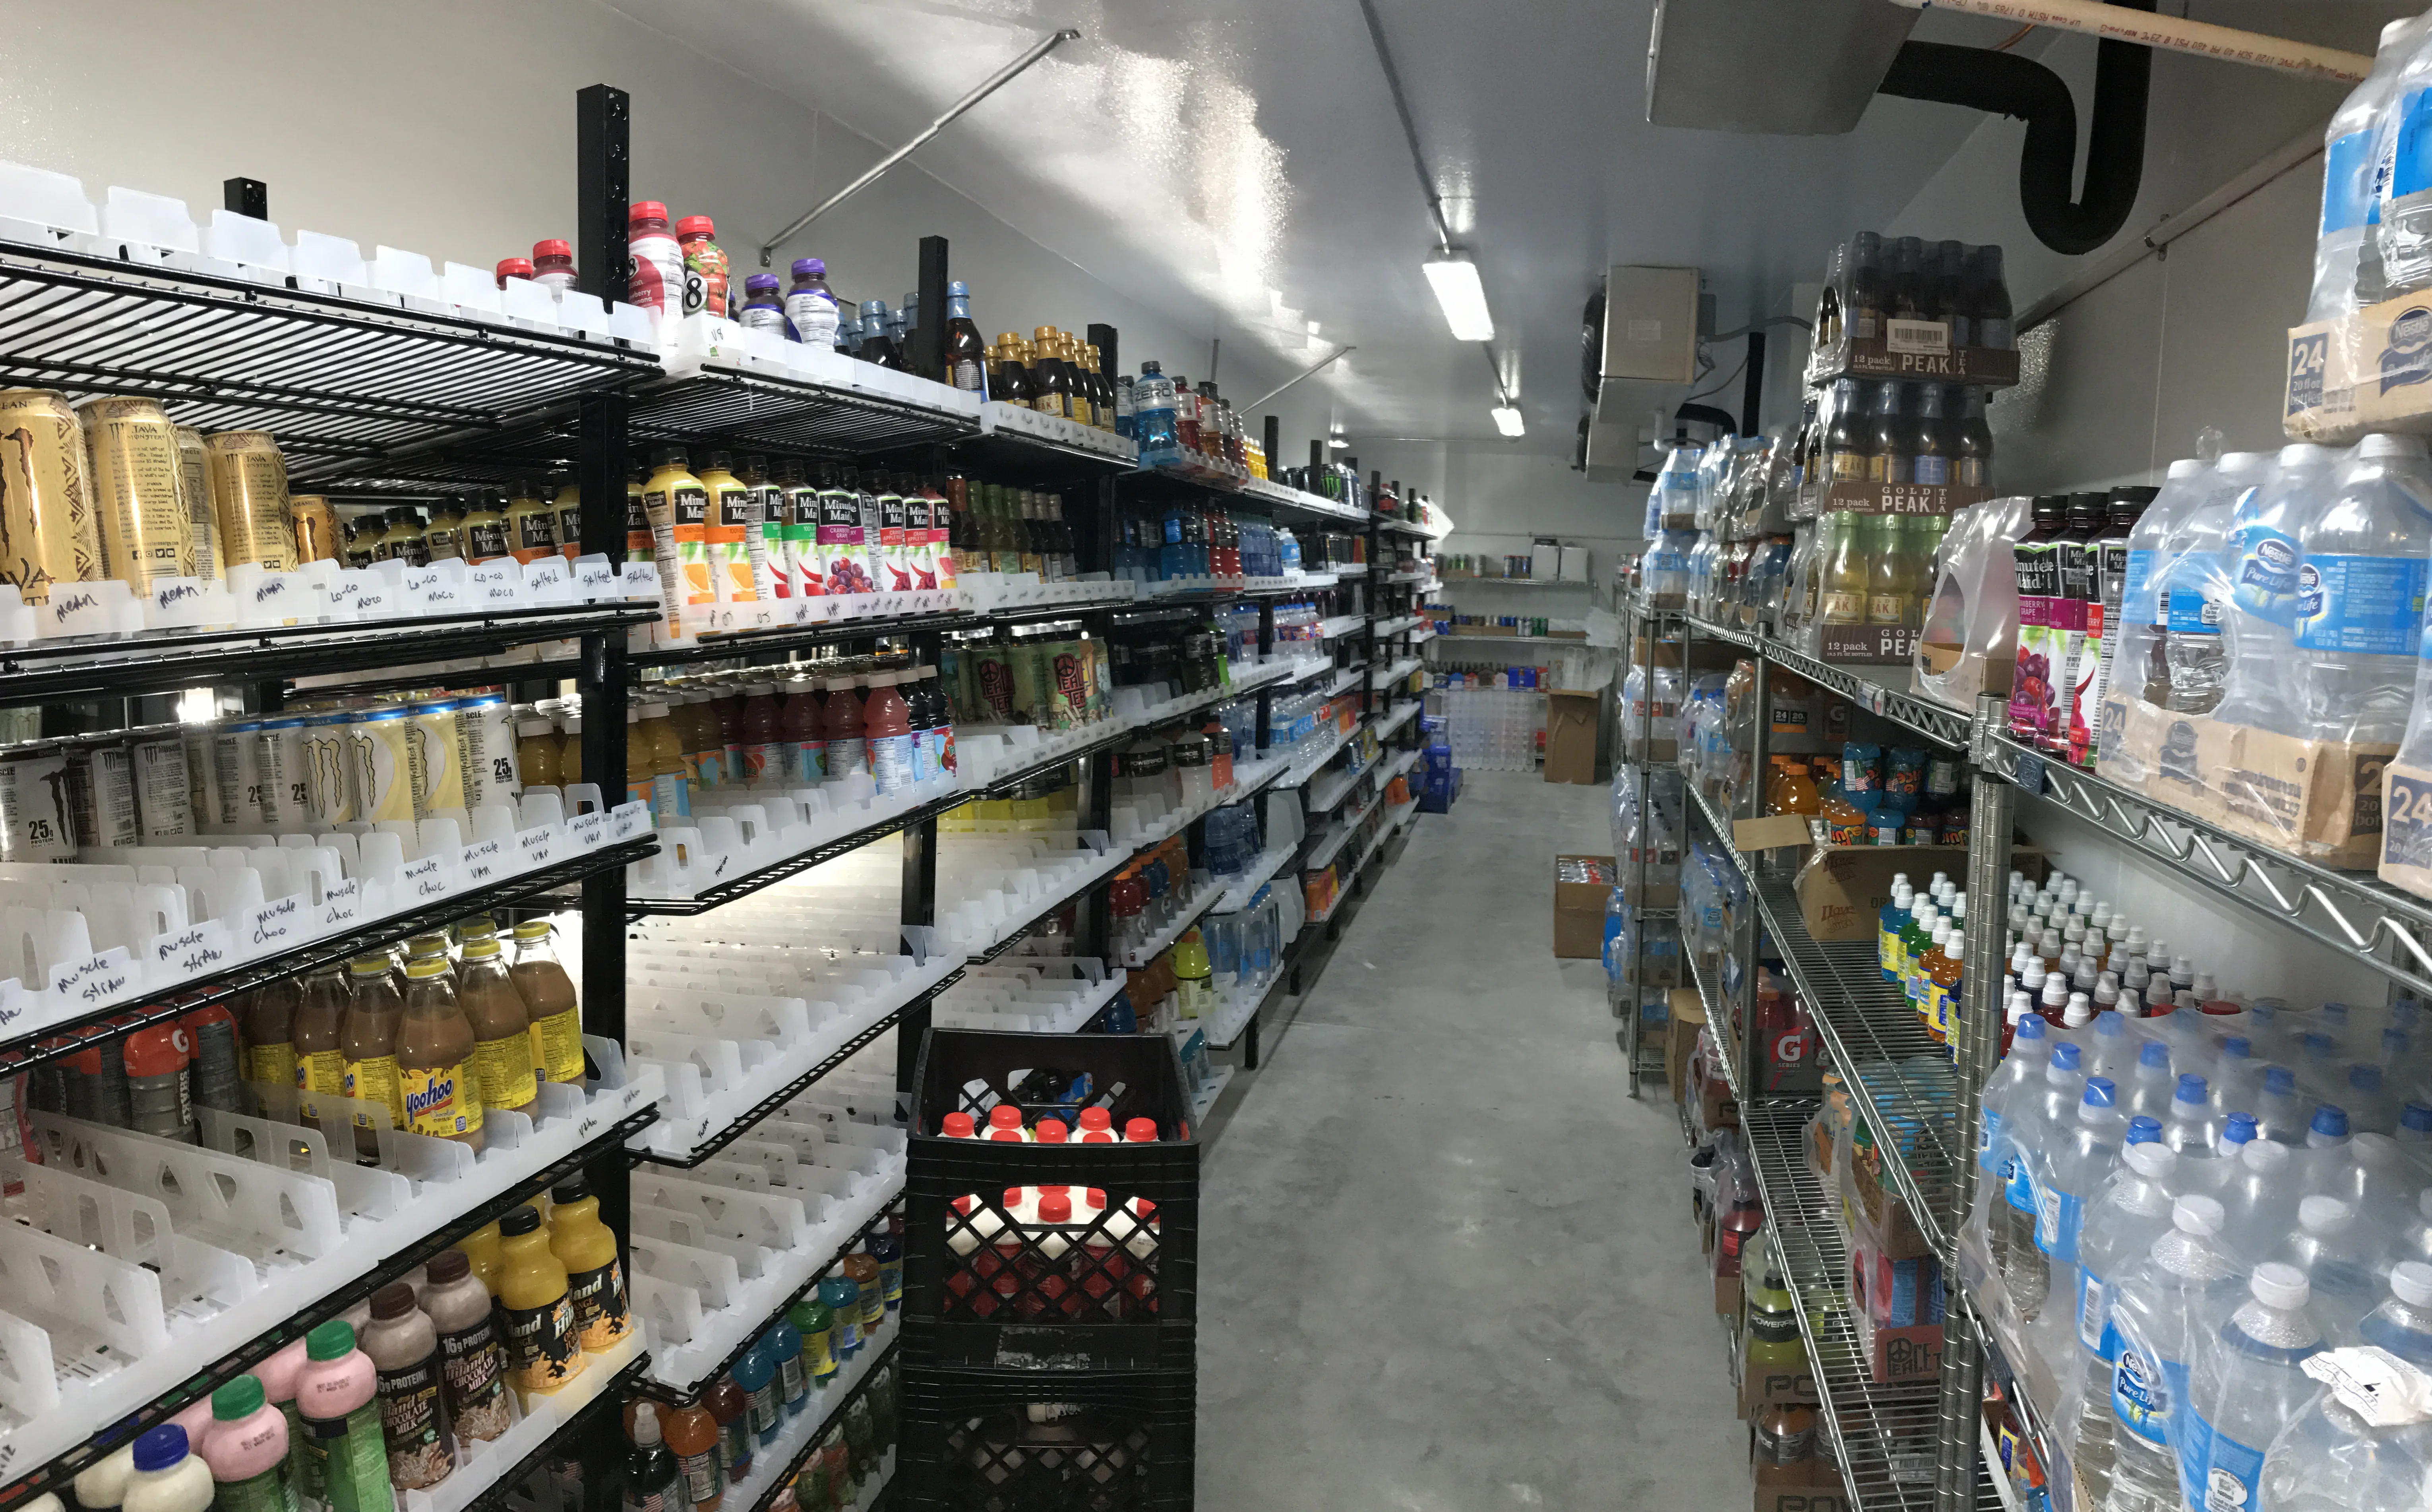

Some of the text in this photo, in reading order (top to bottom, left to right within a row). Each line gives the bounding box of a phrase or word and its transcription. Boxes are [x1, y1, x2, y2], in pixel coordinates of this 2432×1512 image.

[1994, 4, 2014, 16] 1785
[2027, 10, 2049, 22] ASTM
[1854, 355, 1890, 366] 12 pack
[1902, 354, 1950, 374] PEAK
[1958, 350, 1967, 375] TEA
[2293, 340, 2325, 376] 24
[2293, 380, 2303, 391] 20
[1136, 388, 1171, 402] ZERO
[132, 423, 158, 434] JAVA
[245, 453, 266, 463] JAVA
[1847, 499, 1870, 507] pack
[1882, 495, 1931, 513] PEAK
[1938, 489, 1947, 513] TEA
[2246, 567, 2292, 590] Pure Life
[2302, 597, 2318, 612] Life
[1843, 642, 1868, 652] pack
[1880, 639, 1916, 656] PEA
[2105, 705, 2123, 733] 24
[2357, 761, 2382, 795] 2
[2360, 800, 2378, 812] 20
[2391, 785, 2432, 829] 24
[1777, 1035, 1801, 1062] G
[456, 1117, 466, 1125] 230
[574, 1297, 594, 1311] ANGE
[442, 1336, 463, 1354] 16g
[378, 1375, 391, 1393] 6g
[468, 1375, 488, 1392] MILK
[2119, 1376, 2139, 1398] Pure
[396, 1421, 417, 1435] MILK
